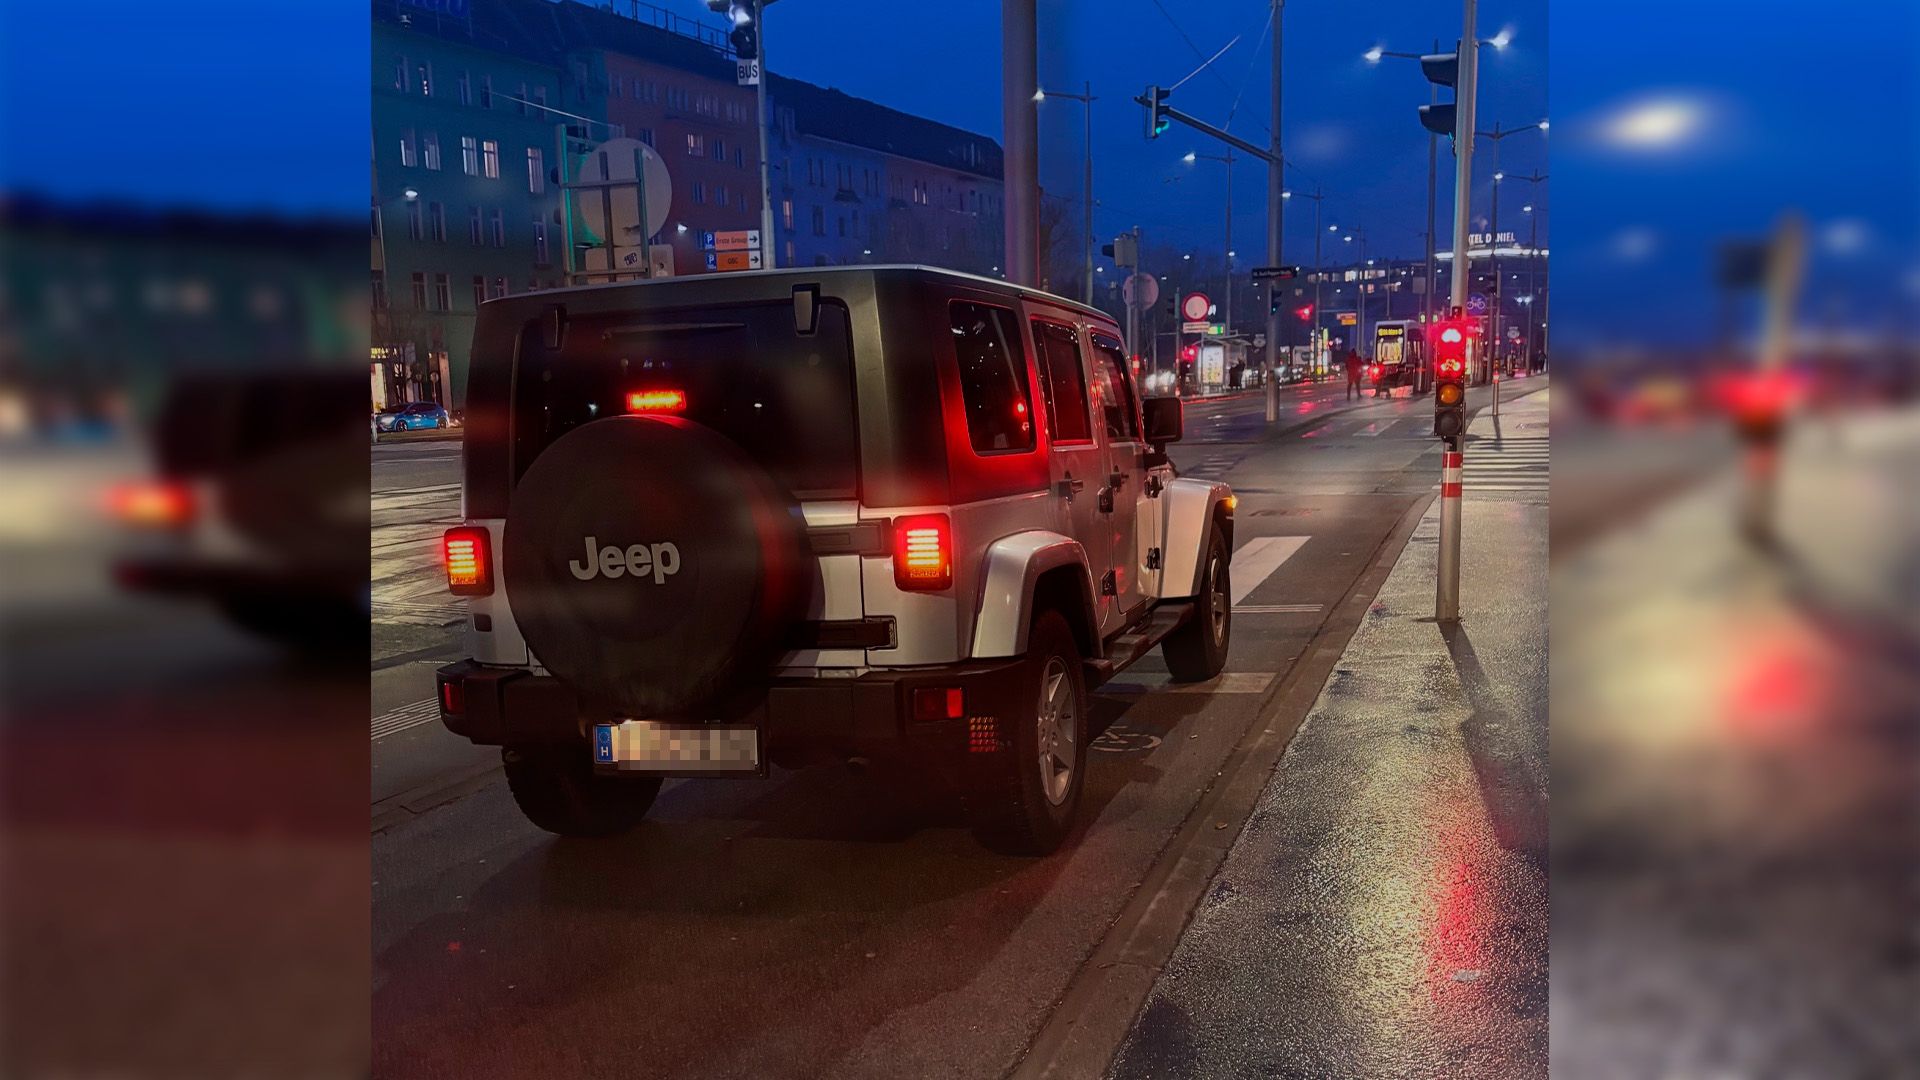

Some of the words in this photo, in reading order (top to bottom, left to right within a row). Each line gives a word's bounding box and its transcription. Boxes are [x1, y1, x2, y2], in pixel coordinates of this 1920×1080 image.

[738, 65, 757, 78] BUS
[1485, 232, 1515, 243] DNIEL
[569, 536, 681, 585] Jeep
[601, 746, 608, 756] H
